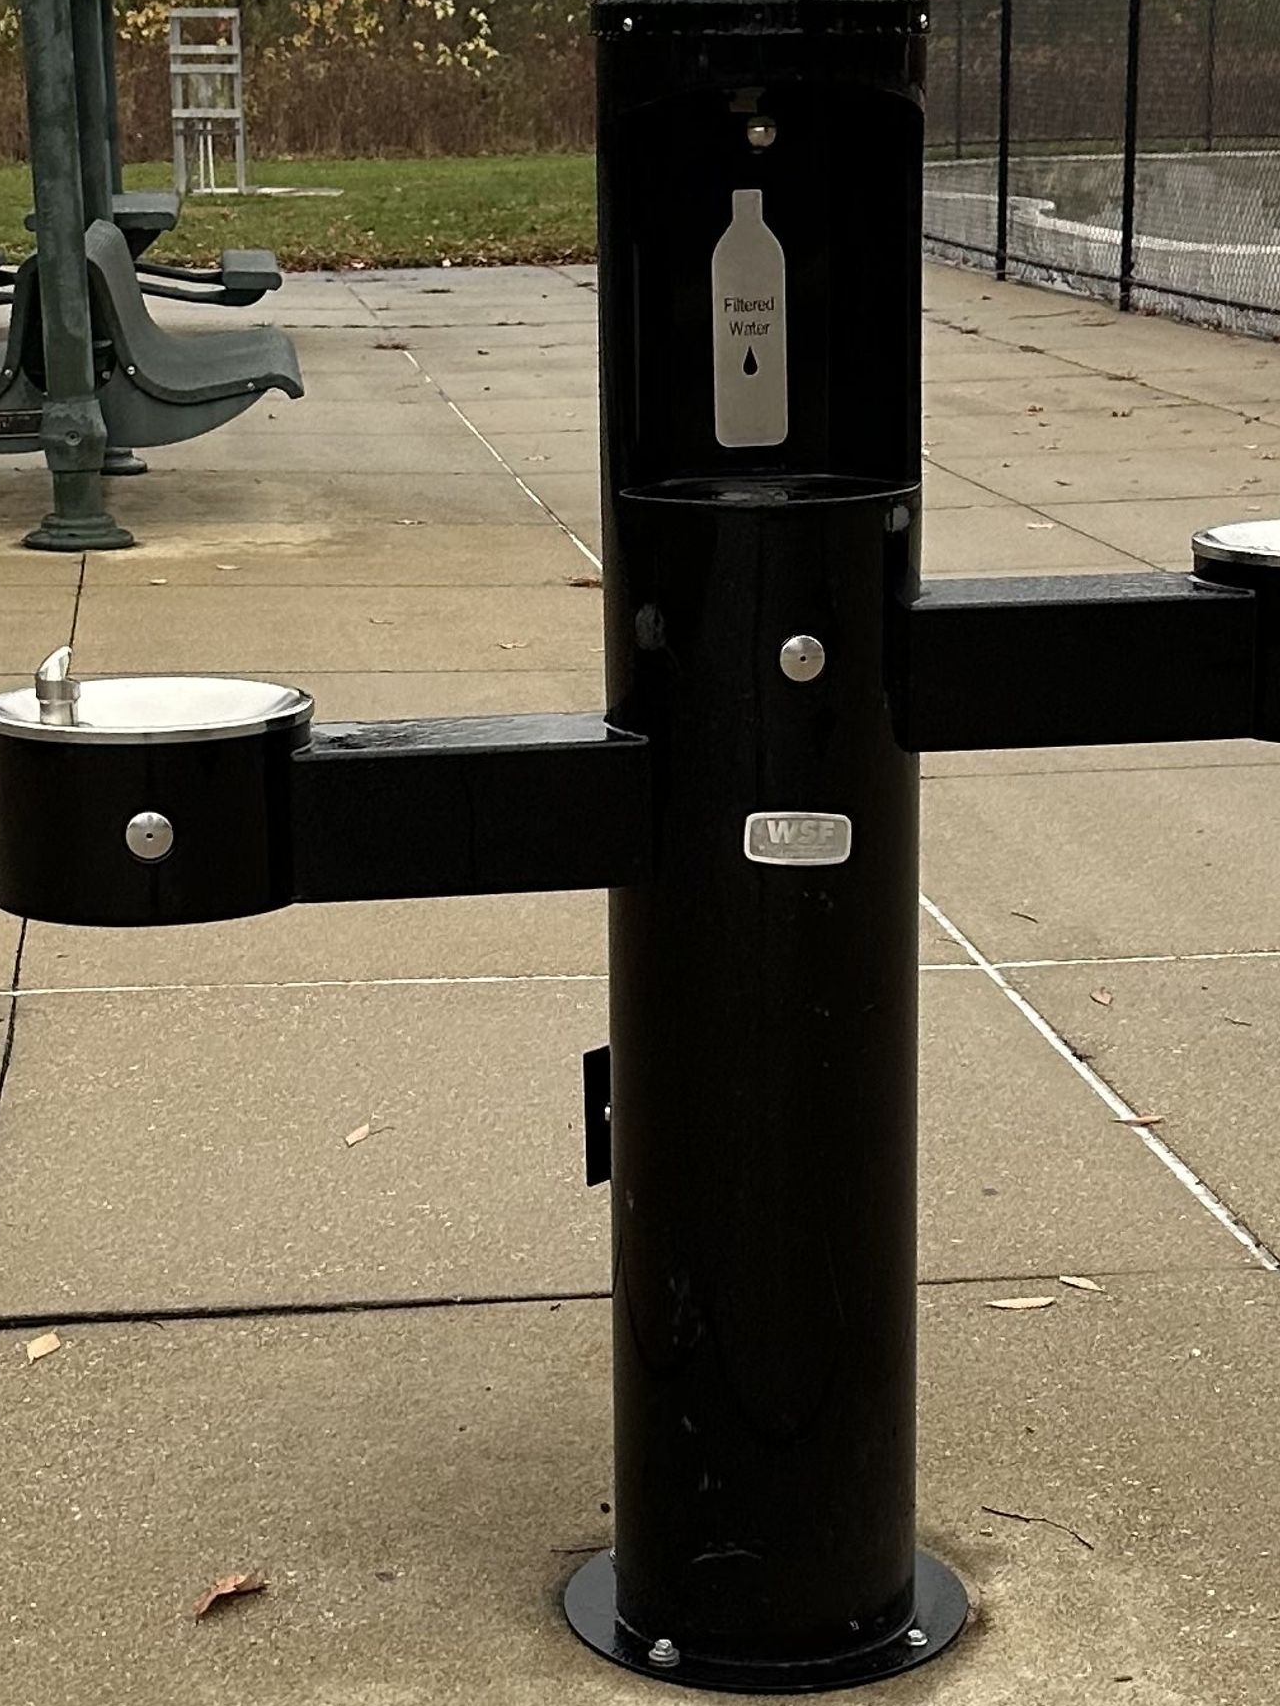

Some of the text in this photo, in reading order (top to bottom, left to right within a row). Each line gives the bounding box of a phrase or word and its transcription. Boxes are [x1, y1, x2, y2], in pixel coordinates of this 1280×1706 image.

[723, 296, 774, 313] Filtered
[729, 321, 771, 337] Water
[766, 819, 835, 845] WSF
